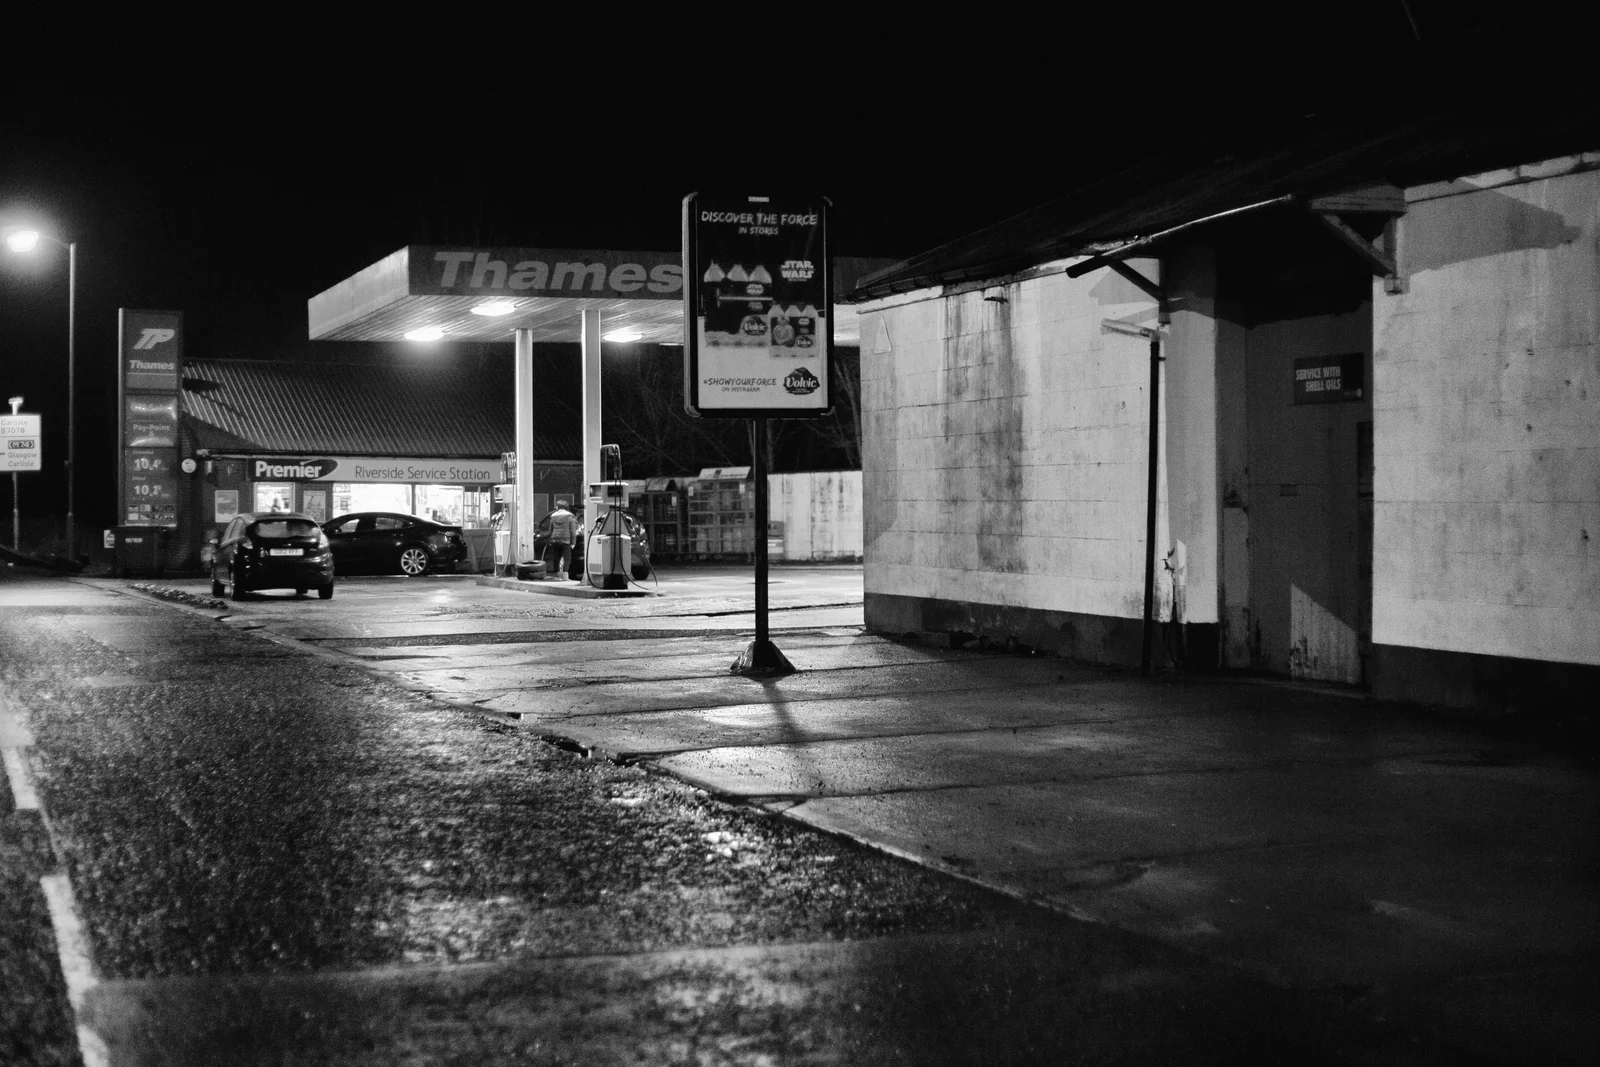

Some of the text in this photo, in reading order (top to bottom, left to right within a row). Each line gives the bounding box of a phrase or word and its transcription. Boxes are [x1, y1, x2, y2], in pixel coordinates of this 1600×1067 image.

[701, 211, 818, 226] DISCOVER THE FORCE
[749, 227, 779, 235] STORES
[780, 260, 814, 269] STAR
[434, 252, 683, 293] Thames
[781, 270, 815, 279] WARS
[129, 359, 175, 370] Thames
[1295, 366, 1341, 381] SERVICE WITH
[785, 376, 817, 388] Volvic
[1305, 378, 1341, 392] SHELL OILS
[8, 451, 38, 459] Glasgow
[255, 461, 322, 478] Premier
[355, 465, 491, 480] Riverside Service Station
